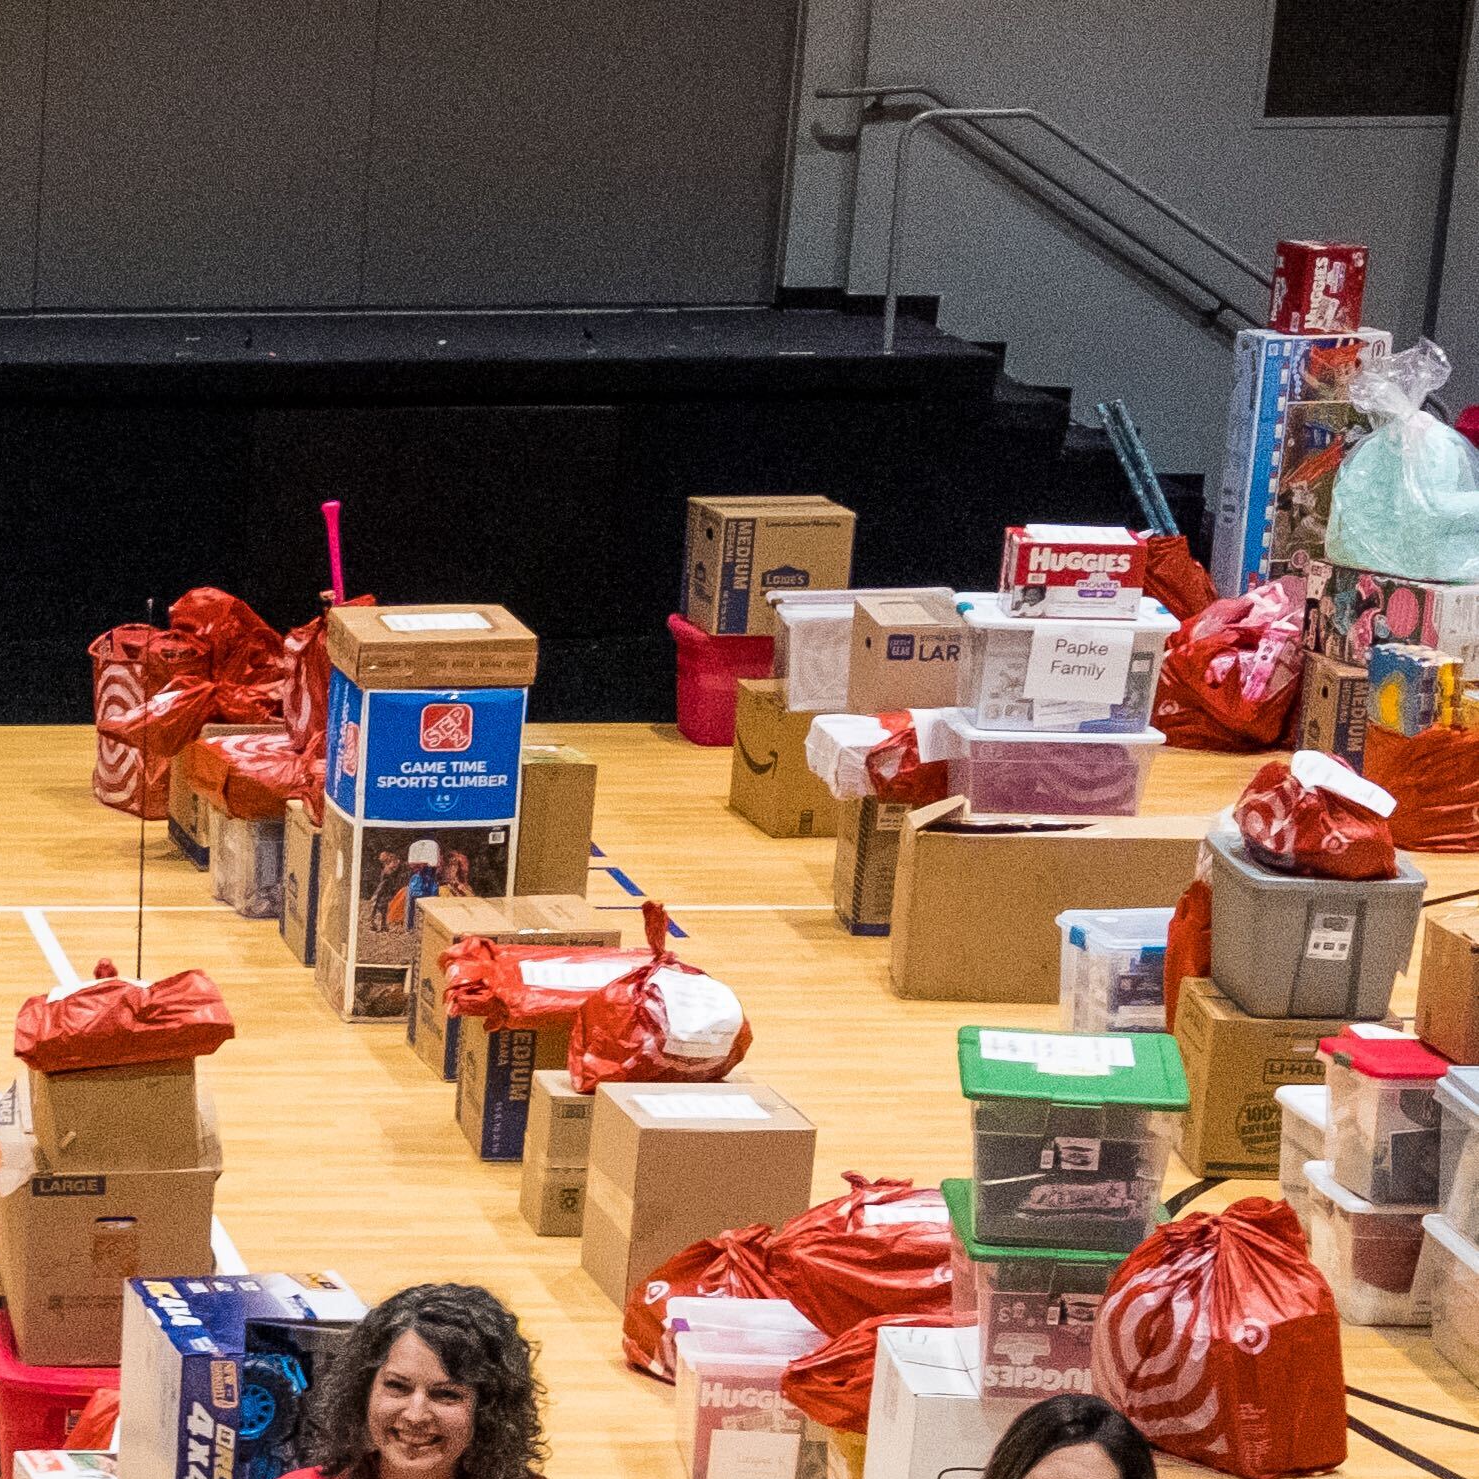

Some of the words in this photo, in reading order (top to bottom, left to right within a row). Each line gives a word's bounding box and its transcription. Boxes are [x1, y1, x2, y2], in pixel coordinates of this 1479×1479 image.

[733, 521, 753, 590] MEDIUM
[1029, 547, 1131, 572] HUGGIES
[919, 645, 961, 662] LAR
[1056, 639, 1109, 657] Papke
[1050, 660, 1105, 680] Family
[424, 706, 466, 747] STEP
[400, 762, 446, 774] GAME
[450, 761, 487, 773] TIME
[377, 776, 437, 788] SPORTS
[442, 775, 508, 788] CLIMBER
[509, 1032, 533, 1101] EDIUM
[40, 1179, 98, 1193] LARGE
